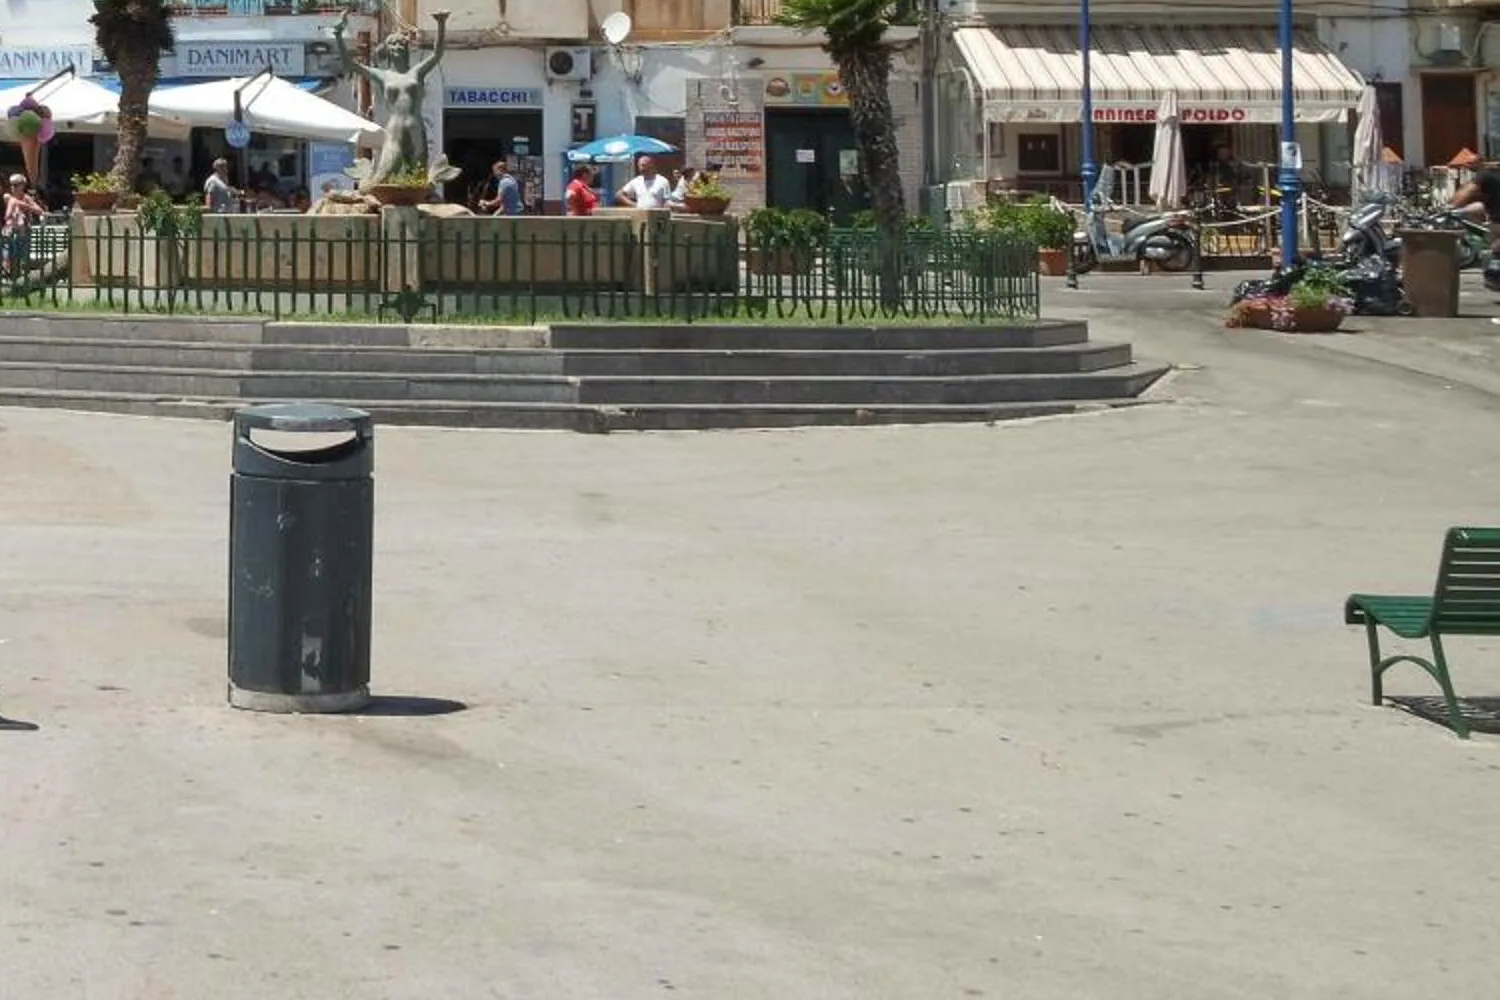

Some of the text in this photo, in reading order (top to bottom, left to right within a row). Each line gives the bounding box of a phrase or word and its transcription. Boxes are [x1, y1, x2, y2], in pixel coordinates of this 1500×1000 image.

[187, 46, 296, 66] DANIMART
[450, 91, 528, 104] TABACCHI
[575, 107, 594, 132] T
[1181, 107, 1246, 122] POLDO
